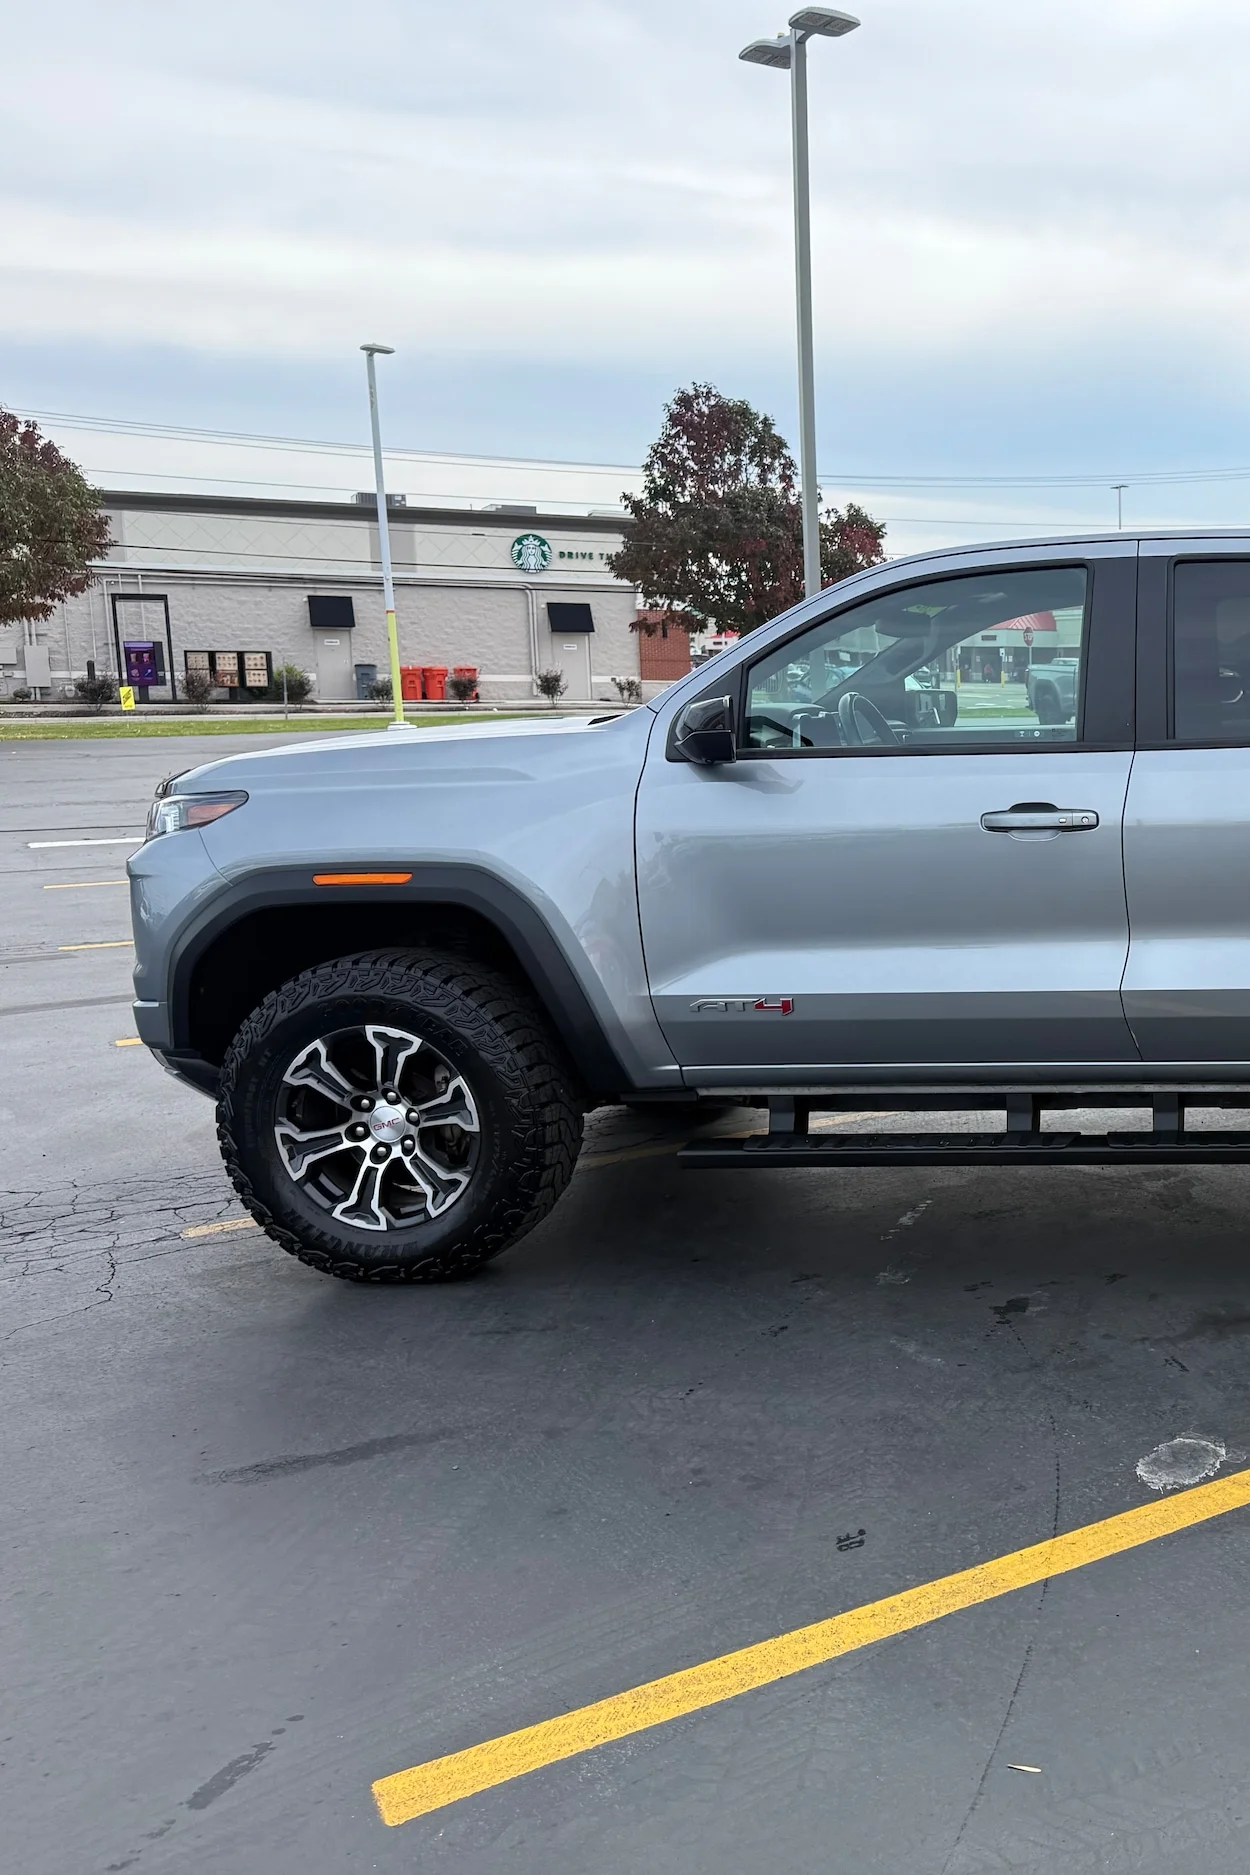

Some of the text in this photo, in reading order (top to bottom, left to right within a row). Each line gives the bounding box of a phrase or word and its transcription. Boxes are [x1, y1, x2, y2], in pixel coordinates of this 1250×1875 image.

[559, 551, 594, 560] DRIVE
[689, 997, 794, 1016] AT4
[373, 1117, 399, 1131] GMC
